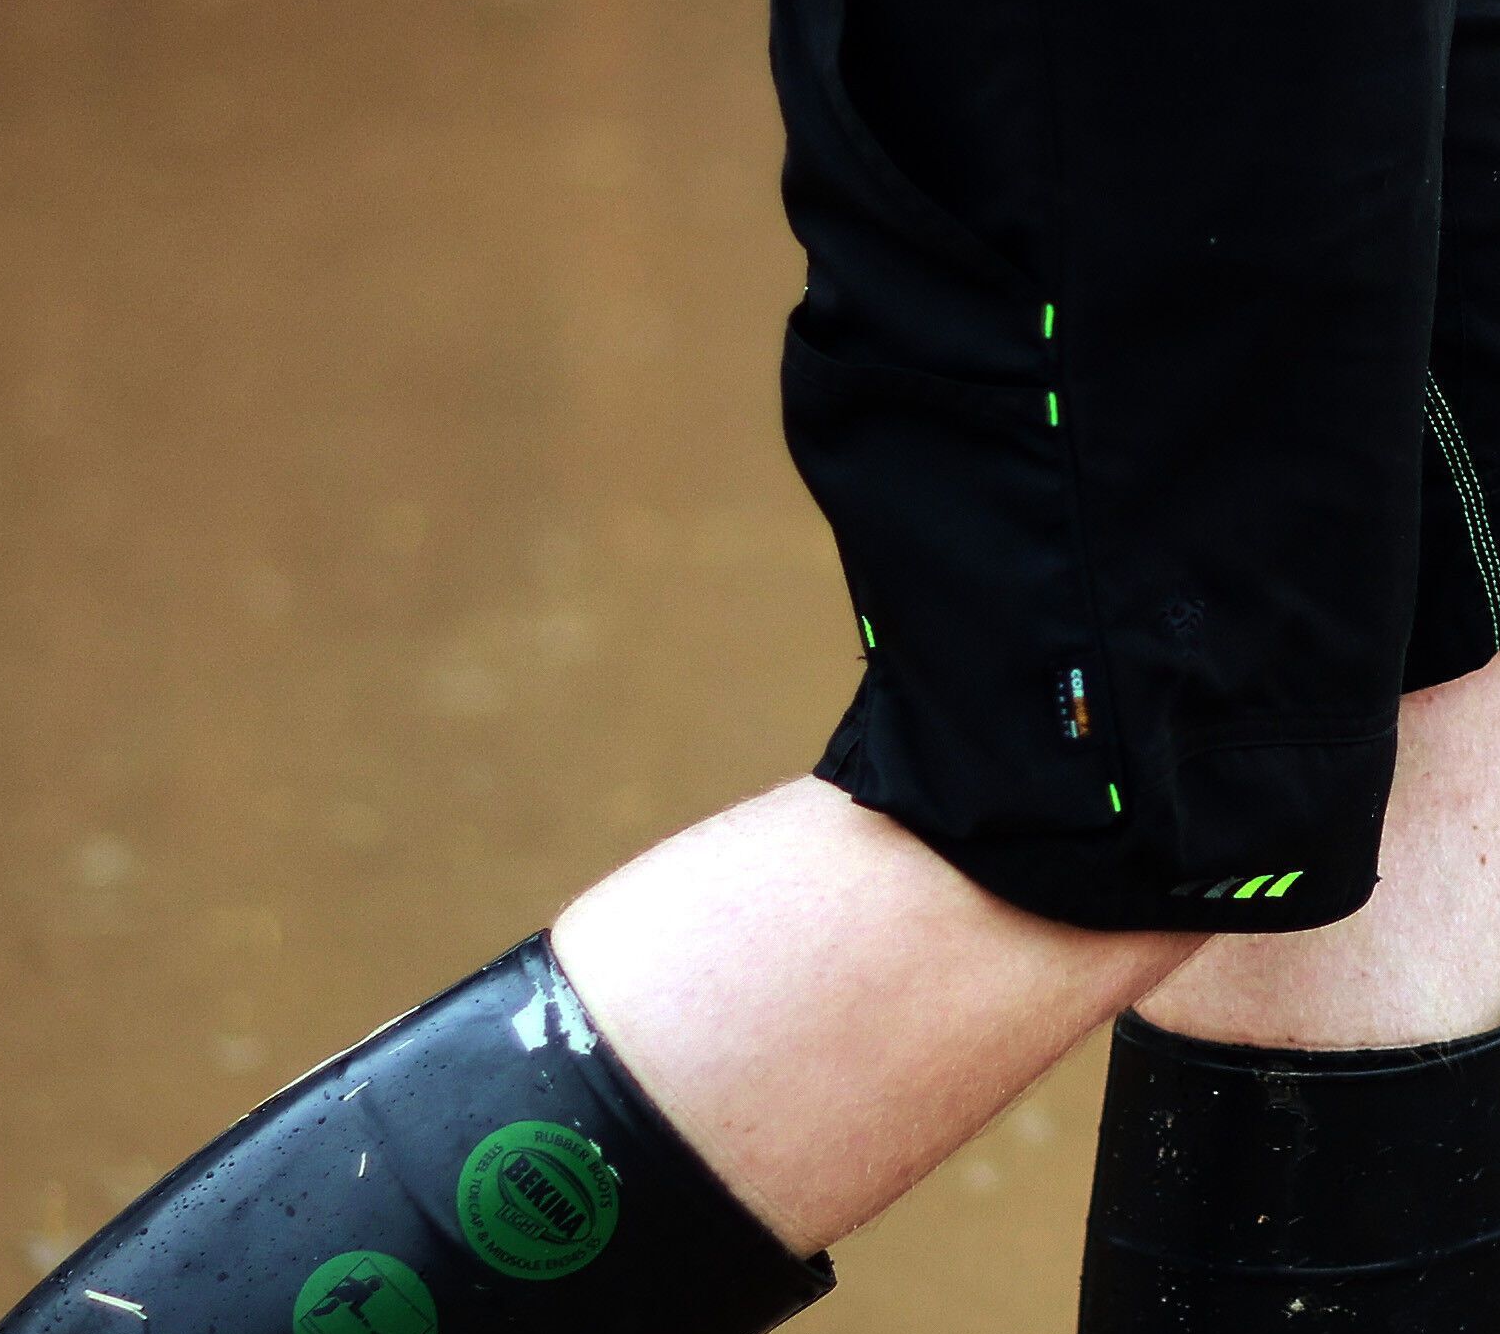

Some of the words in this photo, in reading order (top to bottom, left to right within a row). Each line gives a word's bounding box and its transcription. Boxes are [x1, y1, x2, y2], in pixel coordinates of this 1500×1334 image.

[475, 1143, 504, 1174] STEEL
[534, 1130, 591, 1161] RUBBER
[587, 1160, 613, 1209] BOOTS
[503, 1154, 587, 1240] BEKINA
[477, 1231, 489, 1243] &
[501, 1204, 545, 1240] LIGHT
[485, 1242, 541, 1271] MIDSOLE
